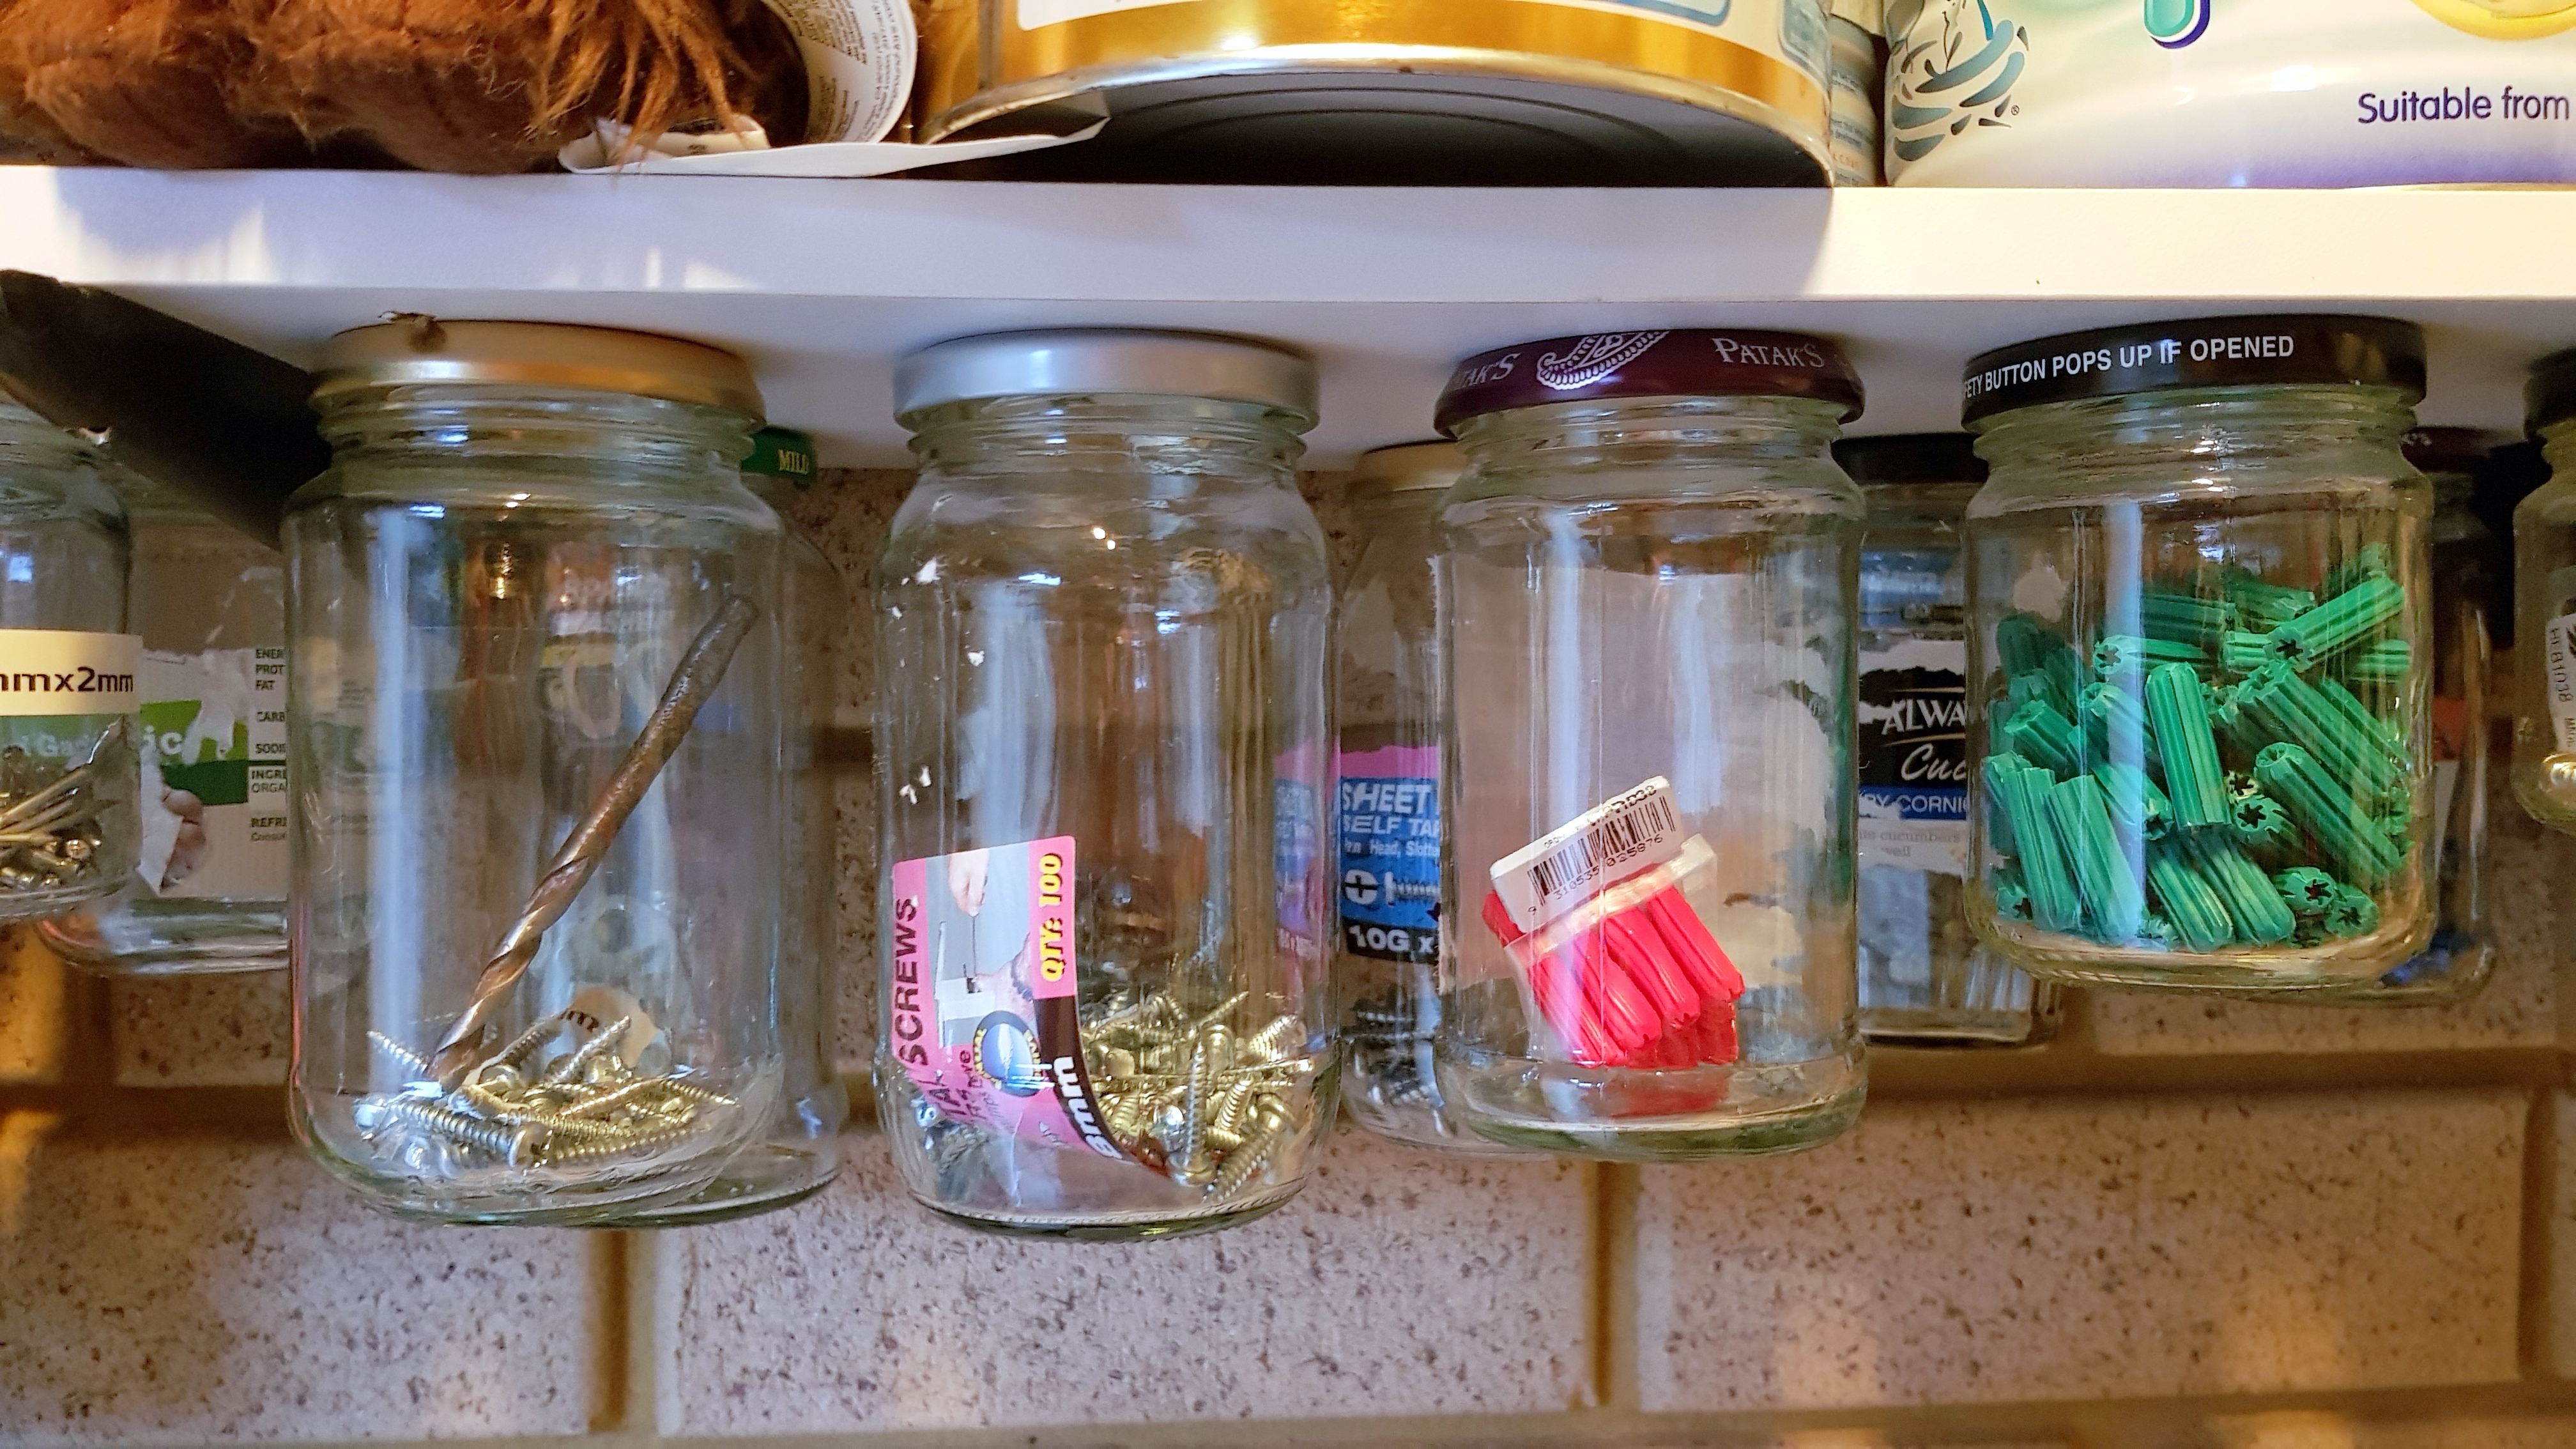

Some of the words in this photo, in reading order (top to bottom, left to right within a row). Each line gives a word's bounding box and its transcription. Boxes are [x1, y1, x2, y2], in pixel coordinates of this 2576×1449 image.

[2358, 86, 2492, 124] Suitable
[2501, 86, 2570, 120] from
[1985, 359, 2046, 392] BUTTON
[2053, 349, 2112, 378] POPS
[2119, 344, 2151, 368] UP
[2159, 339, 2181, 364] IF
[2190, 335, 2294, 360] OPENED
[256, 680, 275, 690] FAT
[1881, 698, 1966, 735] ALWA
[1342, 782, 1431, 815] SHEET
[1343, 815, 1402, 834] SELF
[1038, 853, 1063, 908] 100
[1039, 917, 1066, 983] QTY:
[1349, 925, 1410, 951] 10G
[894, 898, 929, 1066] SCREWS
